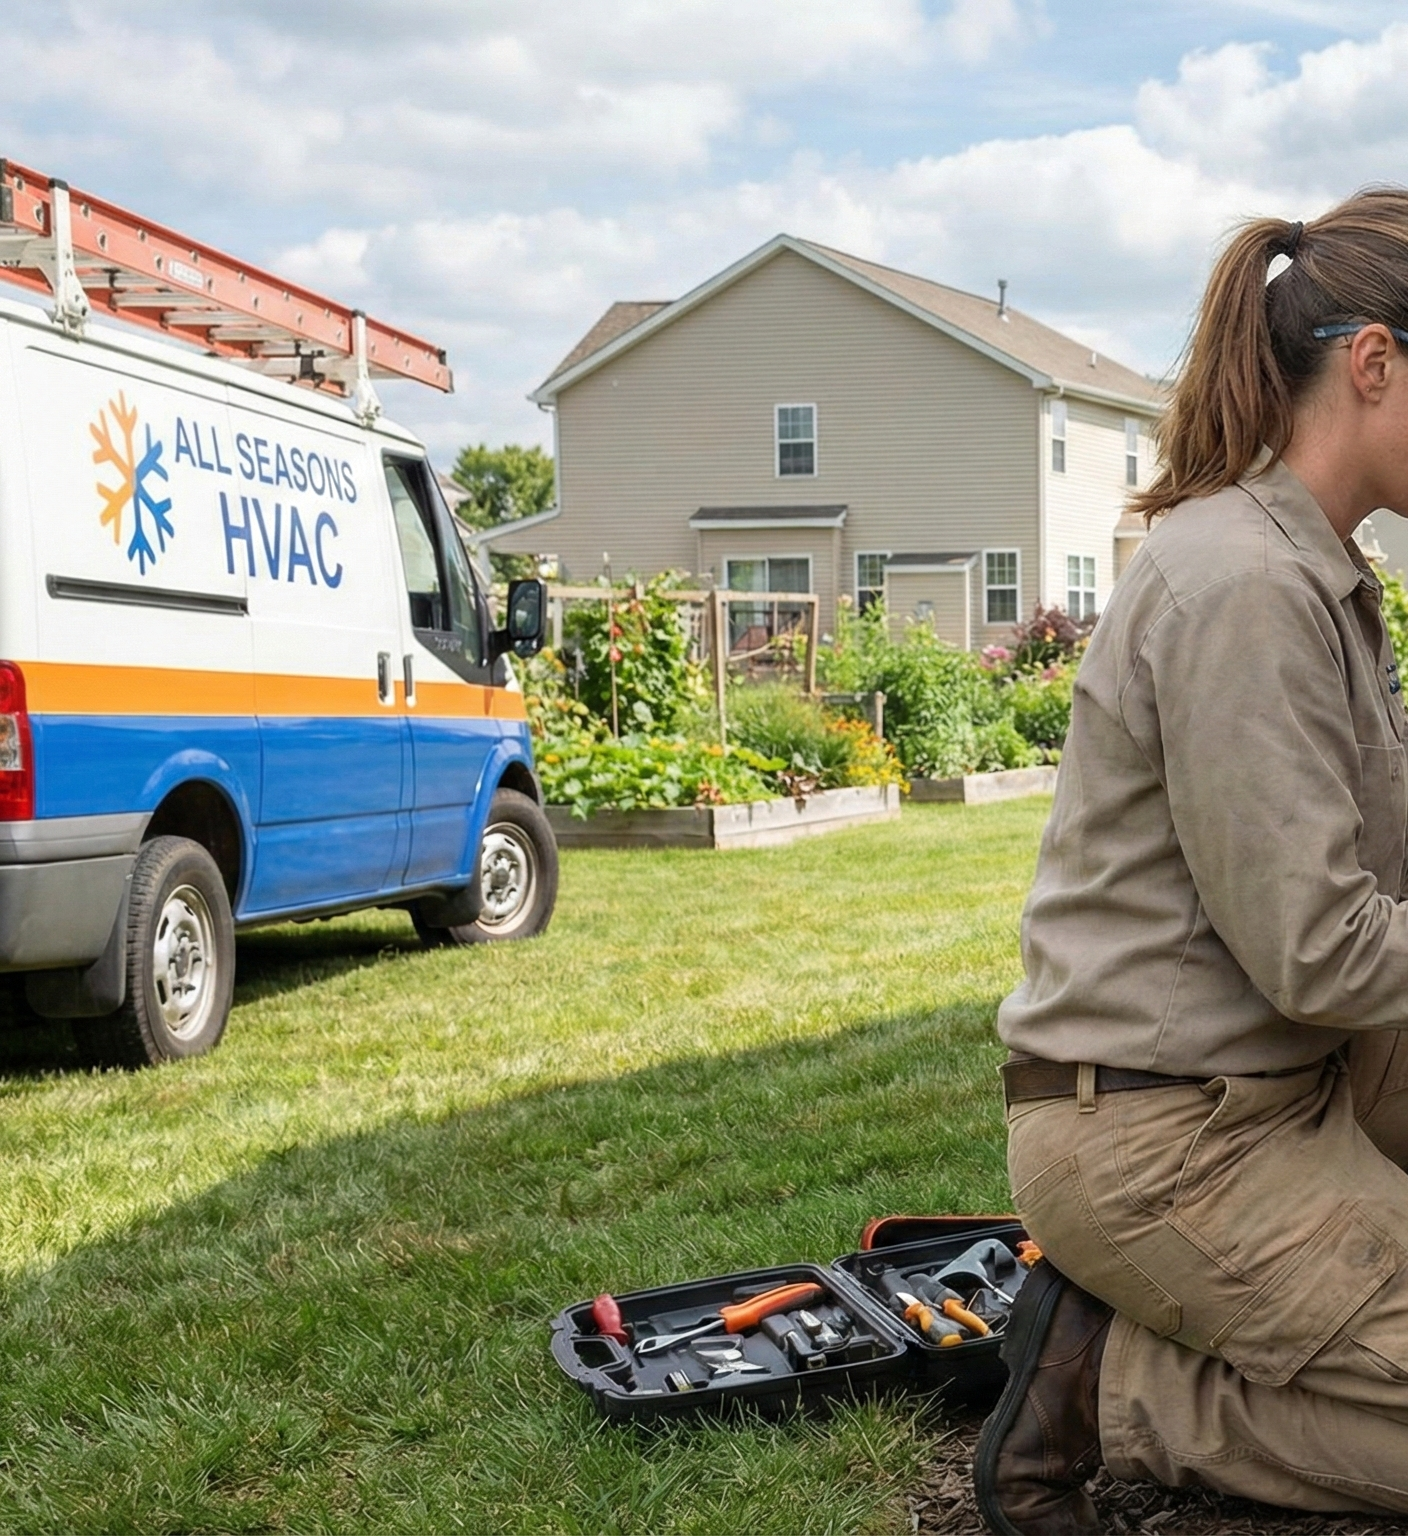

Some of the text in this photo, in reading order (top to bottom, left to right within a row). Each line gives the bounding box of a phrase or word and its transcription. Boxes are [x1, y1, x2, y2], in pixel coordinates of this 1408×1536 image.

[175, 416, 357, 503] ALL SEASONS
[219, 491, 343, 589] HVAC
